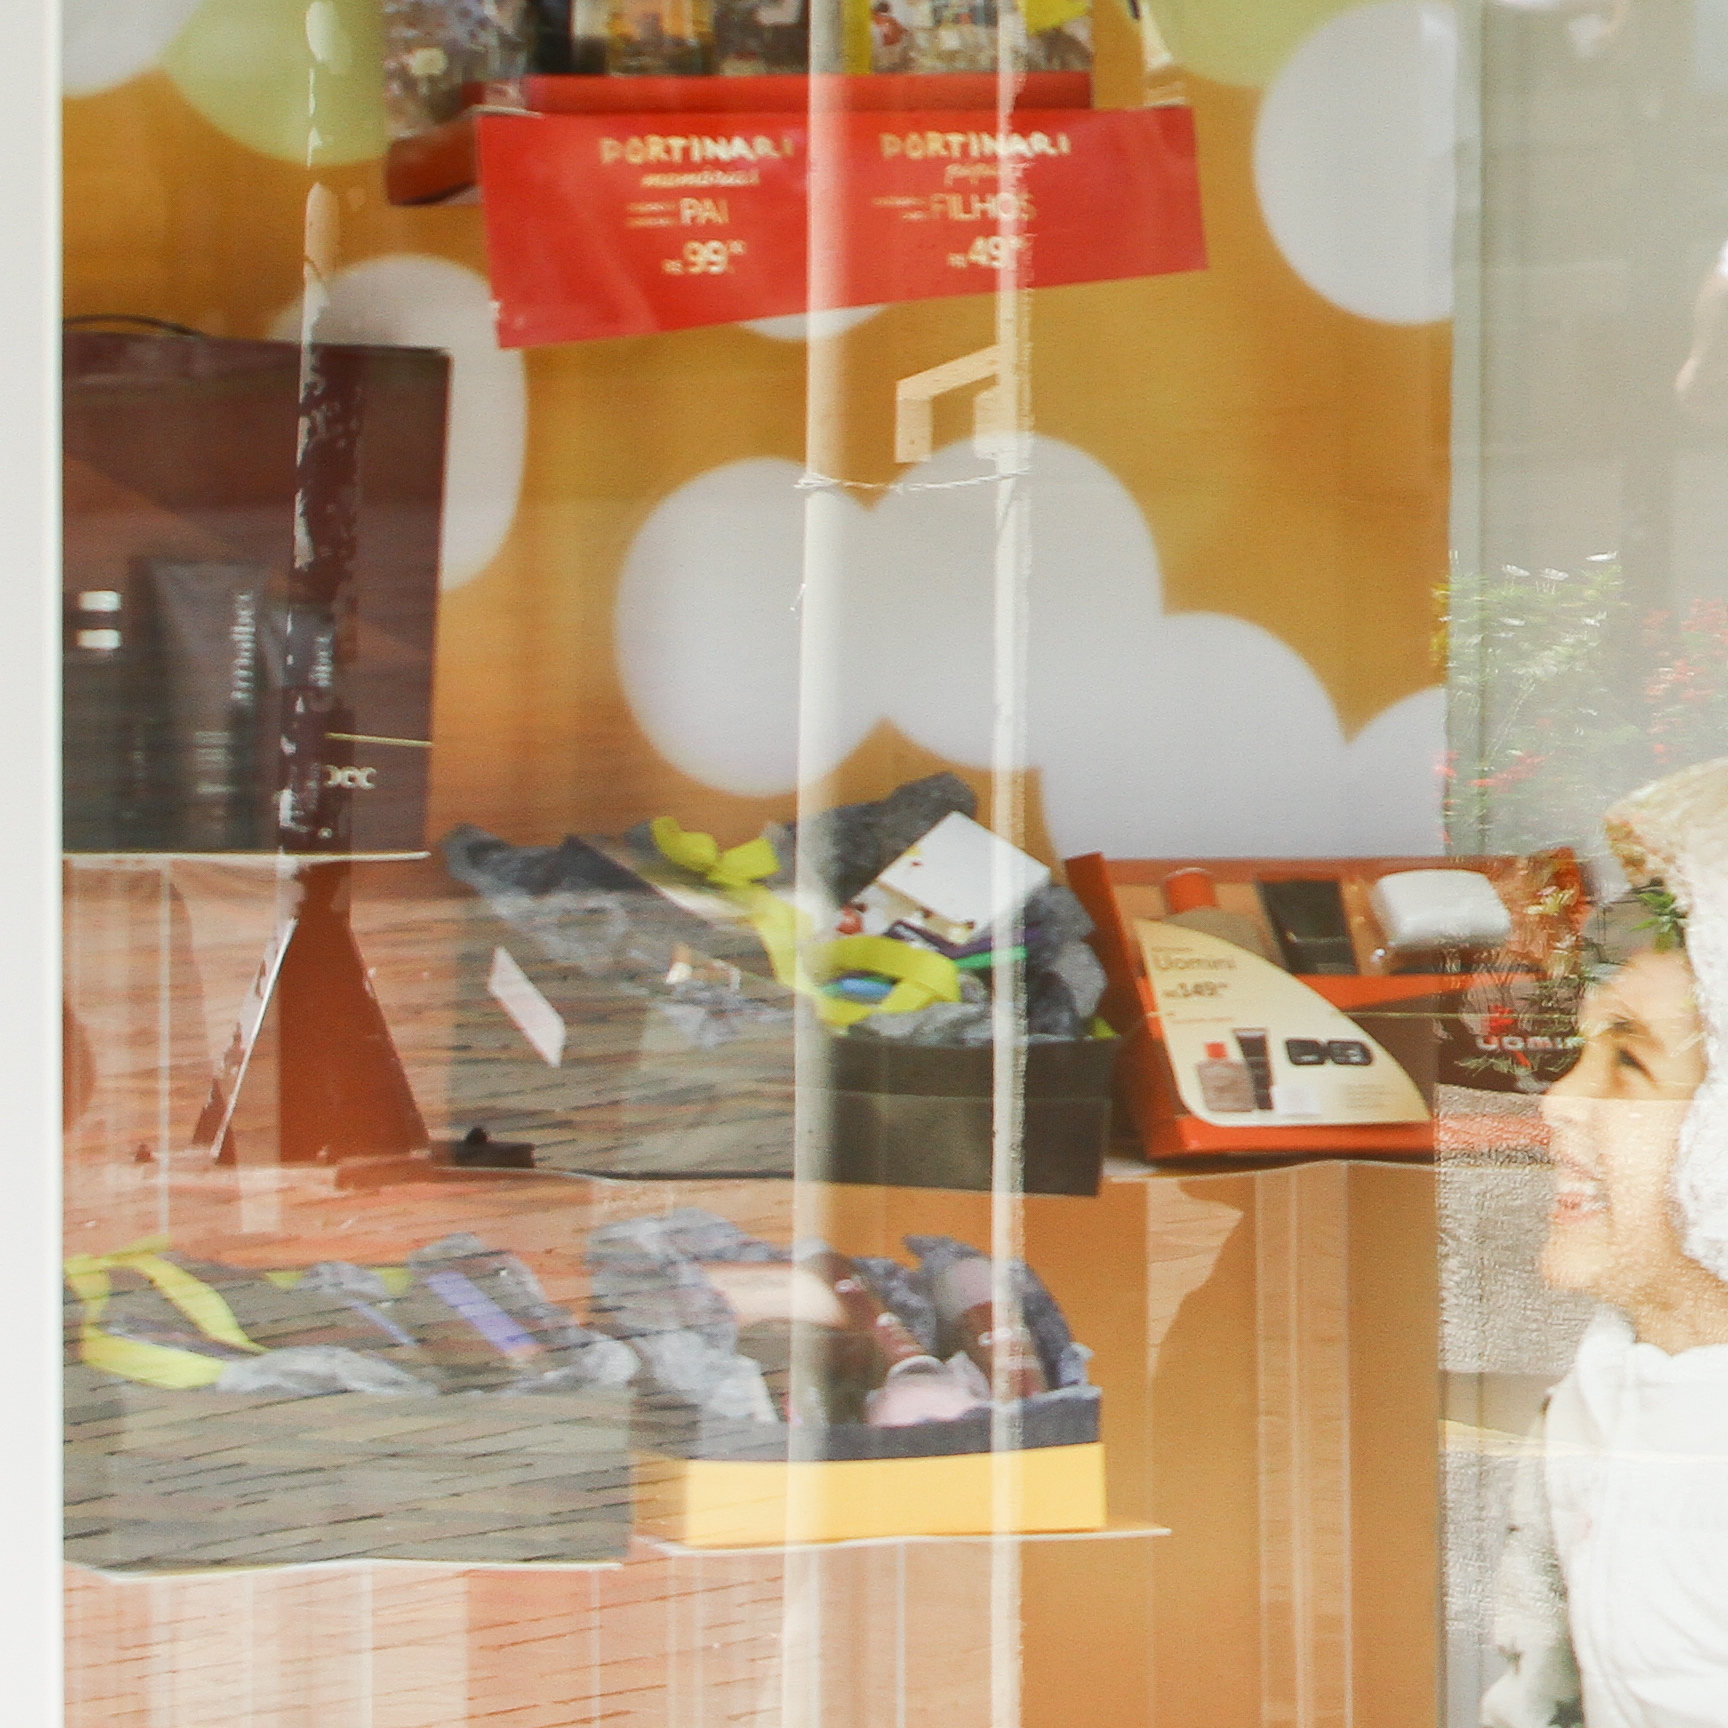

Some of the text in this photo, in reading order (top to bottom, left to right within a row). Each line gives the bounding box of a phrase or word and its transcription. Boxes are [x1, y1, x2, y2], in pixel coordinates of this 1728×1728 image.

[601, 134, 794, 166] PORTINARI
[878, 131, 1072, 160] PORTINARI
[680, 197, 729, 226] PAI
